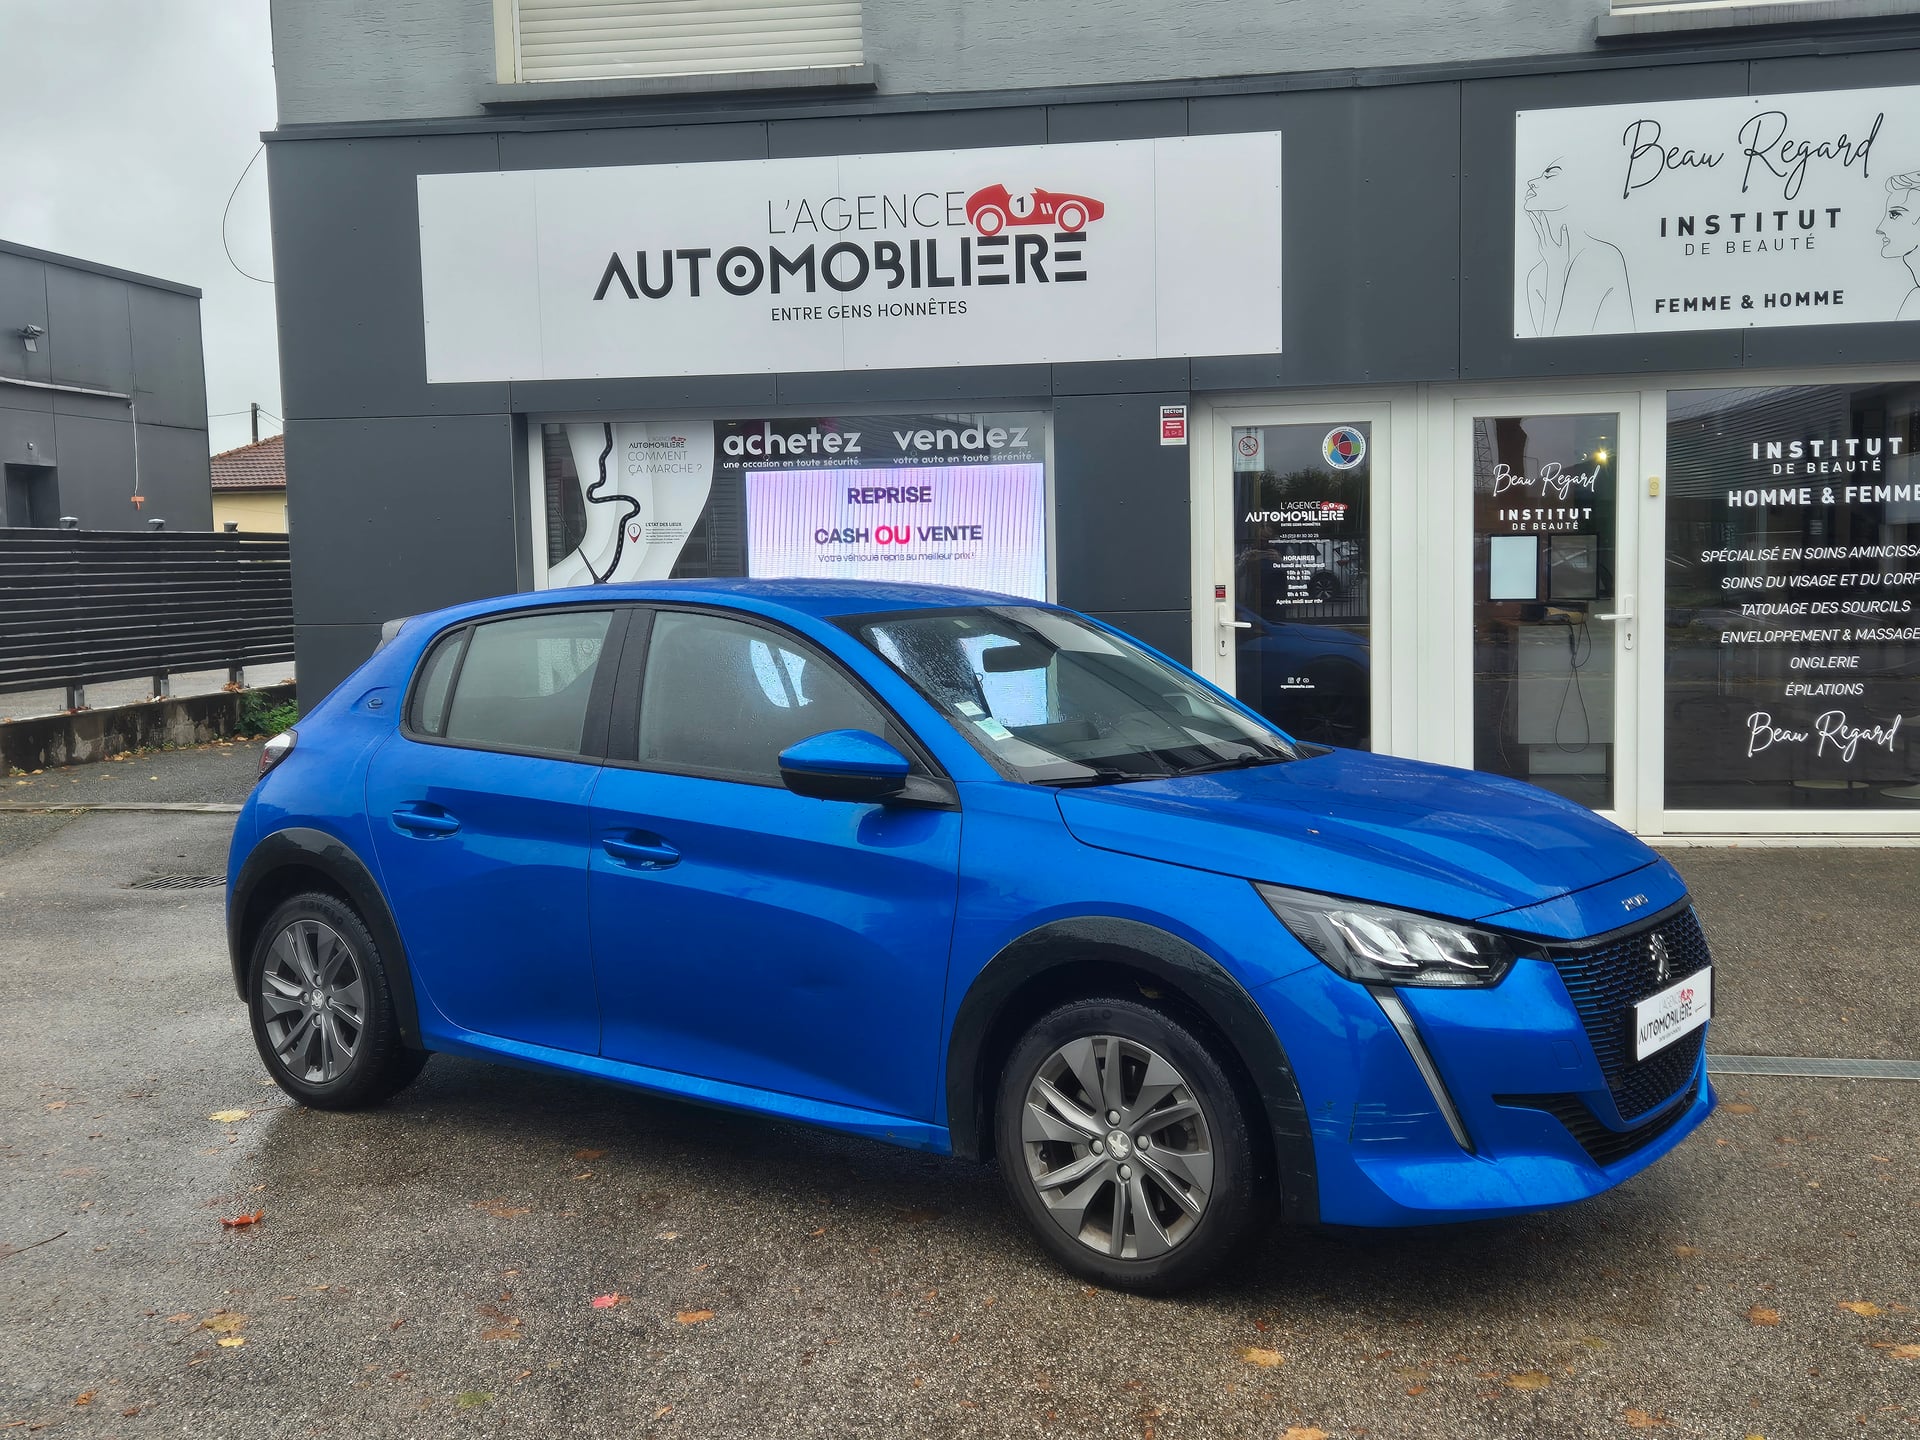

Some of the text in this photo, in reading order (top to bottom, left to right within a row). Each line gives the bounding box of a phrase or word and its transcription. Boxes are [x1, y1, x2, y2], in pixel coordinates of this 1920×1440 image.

[1623, 111, 1884, 200] Beau Regard
[768, 191, 966, 234] L'AGENCE
[1017, 196, 1024, 212] 1
[1660, 208, 1841, 237] INSTITUT
[1685, 233, 1815, 256] DE BEAUTÉ
[771, 298, 968, 321] ENTRE GENS HONNÊTES
[1655, 290, 1844, 313] FEMME & HOMME
[723, 422, 862, 455] achetez
[893, 415, 1029, 451] vendez
[628, 451, 688, 461] COMMENT
[1752, 437, 1903, 459] INSTITUT
[743, 459, 780, 467] occasion
[922, 456, 944, 464] auto
[963, 454, 989, 462] toute
[1773, 457, 1881, 474] DE BEAUTÉ
[646, 464, 693, 474] MARCHE
[1493, 462, 1600, 500] Beau Regard
[848, 486, 932, 505] REPRISE
[1729, 488, 1811, 507] HOMME
[1822, 487, 1835, 504] &
[1281, 501, 1320, 510] L'AGENCE
[1500, 508, 1592, 520] INSTITUT
[1533, 520, 1579, 530] BEAUTÉ
[815, 525, 983, 545] CASH OU VENTE
[1701, 546, 1780, 562] SPÉCIALISÉ
[1782, 548, 1802, 561] EN
[1804, 547, 1848, 560] SOINS
[1721, 576, 1763, 589] SOINS
[1766, 576, 1787, 588] DU
[1789, 575, 1838, 587] VISAGE
[1840, 574, 1858, 586] ET
[1860, 573, 1881, 585] DU
[1741, 600, 1912, 616] TATOUAGE DES SOURCILS
[1721, 629, 1840, 643] ENVELOPPEMENT
[1842, 629, 1851, 641] &
[1790, 656, 1860, 669] ONGLERIE
[1785, 682, 1865, 696] ÉPILATIONS
[1747, 710, 1902, 763] Beau Regard
